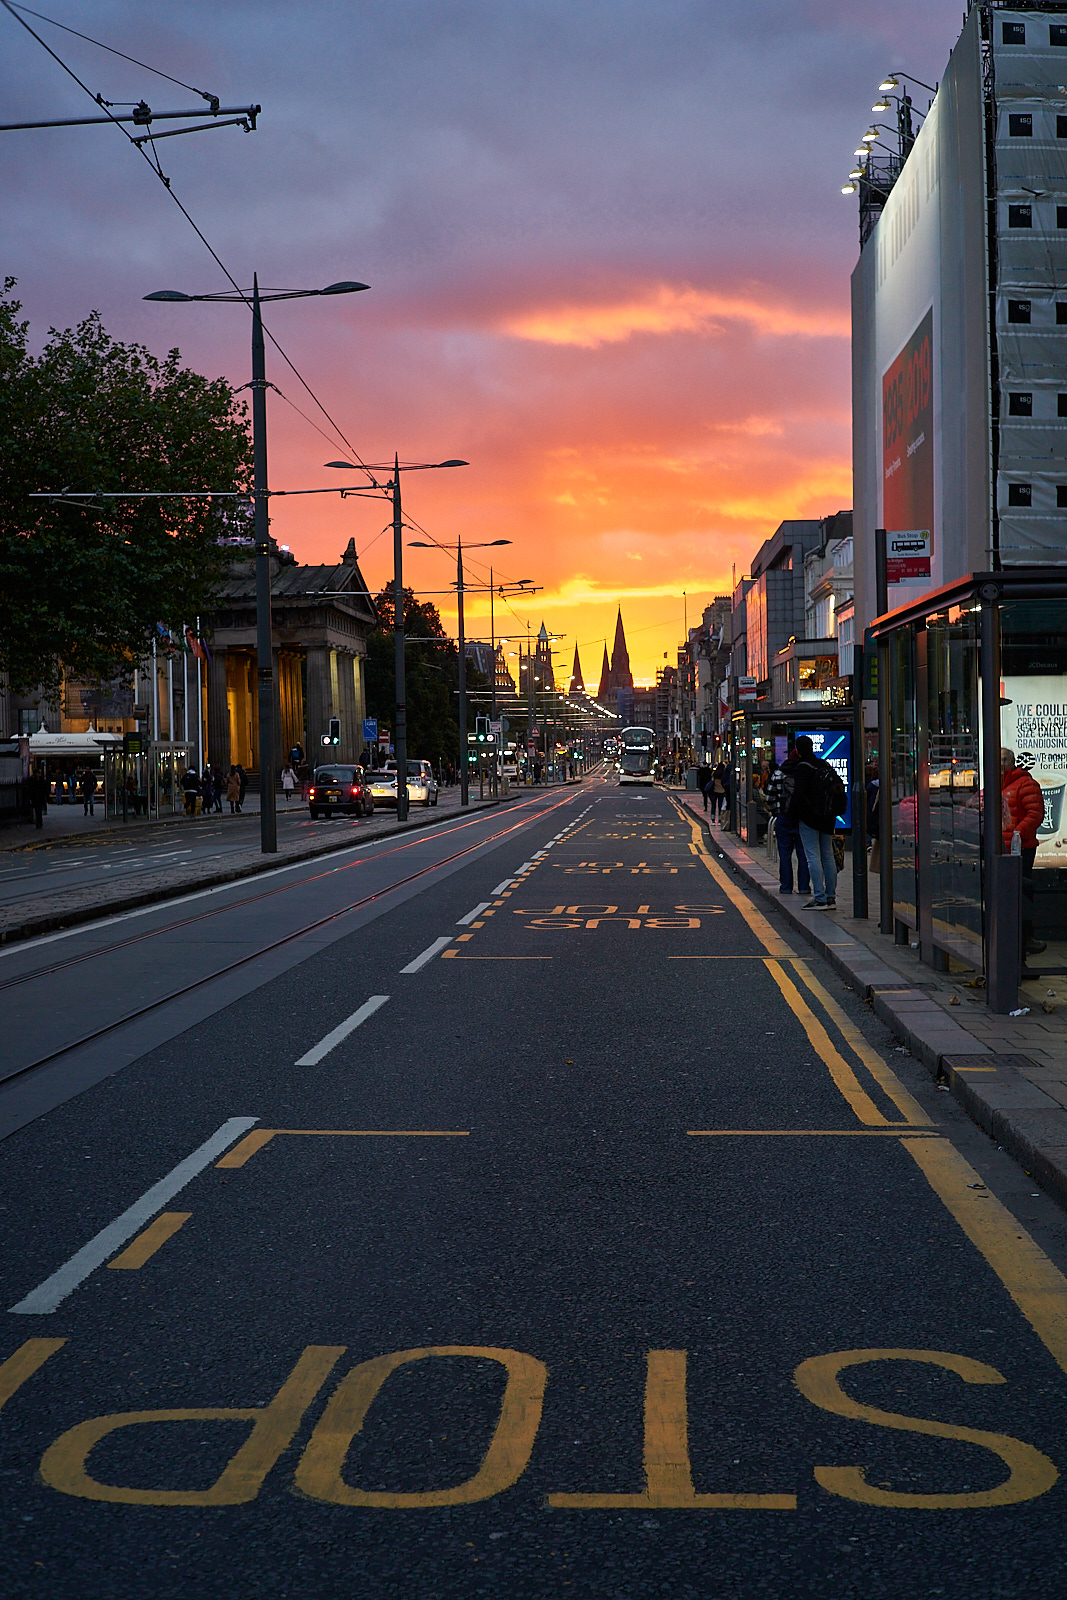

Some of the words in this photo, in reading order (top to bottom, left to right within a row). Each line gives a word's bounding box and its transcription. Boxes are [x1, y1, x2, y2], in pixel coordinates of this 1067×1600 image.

[1020, 117, 1032, 125] isg
[884, 371, 903, 450] 1995
[907, 335, 930, 426] 2019
[1020, 396, 1031, 404] isg
[1019, 487, 1031, 495] isg
[1016, 704, 1032, 716] WE
[1017, 717, 1045, 727] CREATE
[1017, 728, 1035, 738] SIZE
[841, 758, 848, 767] IT
[1040, 761, 1052, 769] for
[512, 904, 726, 915] STOP
[524, 917, 701, 930] BUS
[38, 1344, 1059, 1510] STOP
